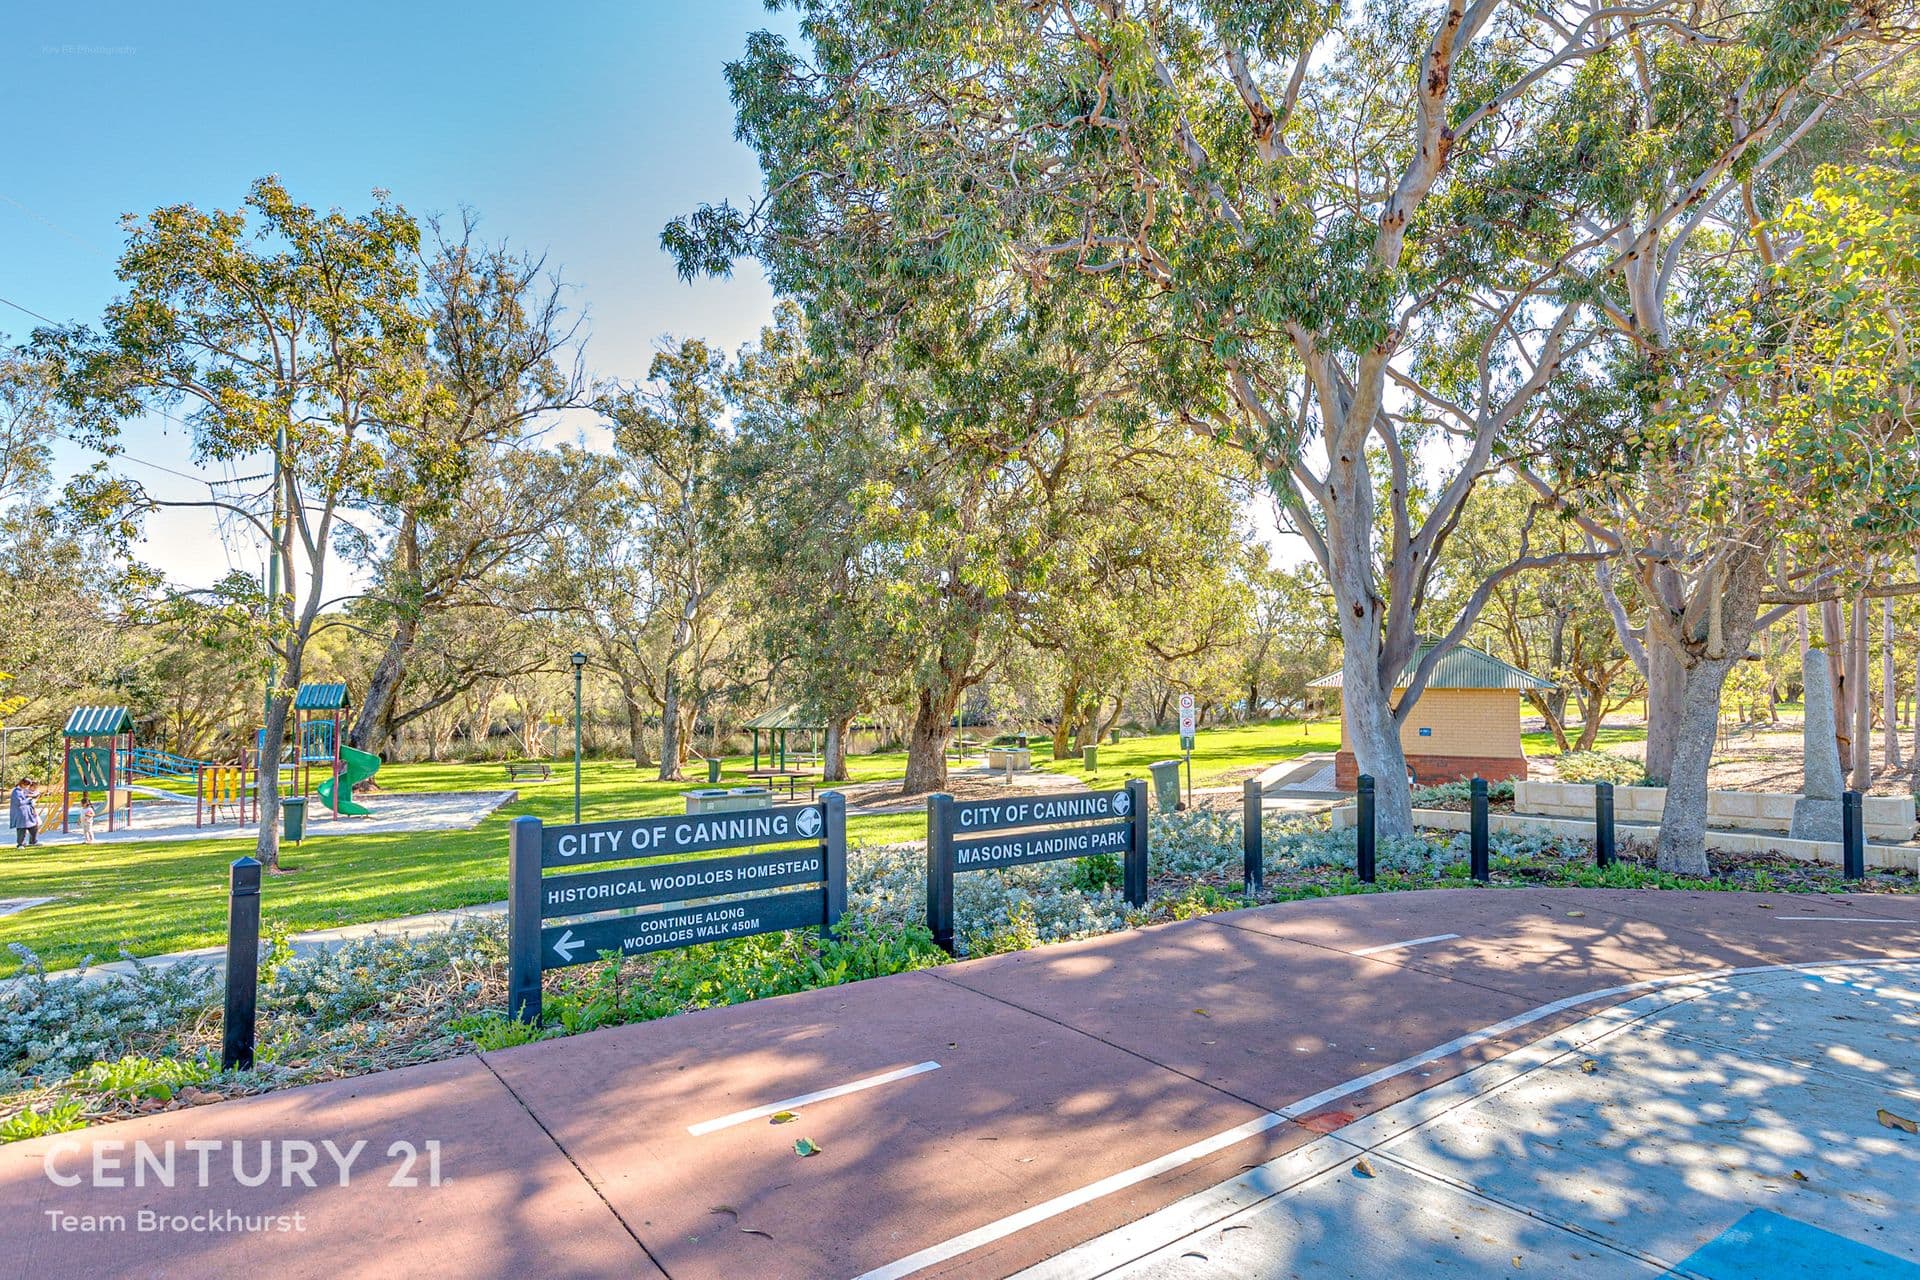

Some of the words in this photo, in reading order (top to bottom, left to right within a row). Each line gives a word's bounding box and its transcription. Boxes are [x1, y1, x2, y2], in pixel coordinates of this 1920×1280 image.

[960, 807, 1001, 826] CITY
[1005, 804, 1029, 822] OF
[1033, 798, 1108, 818] CANNING
[558, 830, 623, 857] CITY
[631, 826, 667, 849] OF
[674, 815, 788, 846] CANNING
[958, 843, 1022, 864] MASONS
[1026, 835, 1087, 856] LANDING
[1091, 831, 1126, 848] PARK
[548, 880, 646, 904] HISTORICAL
[650, 869, 733, 891] WOODLOES
[737, 859, 819, 881] HOMESTEAD
[623, 929, 694, 949] WOODLOES
[697, 923, 729, 937] WALK
[731, 918, 760, 931] 450M
[640, 914, 703, 932] CONTINUE
[706, 907, 745, 922] ALONG
